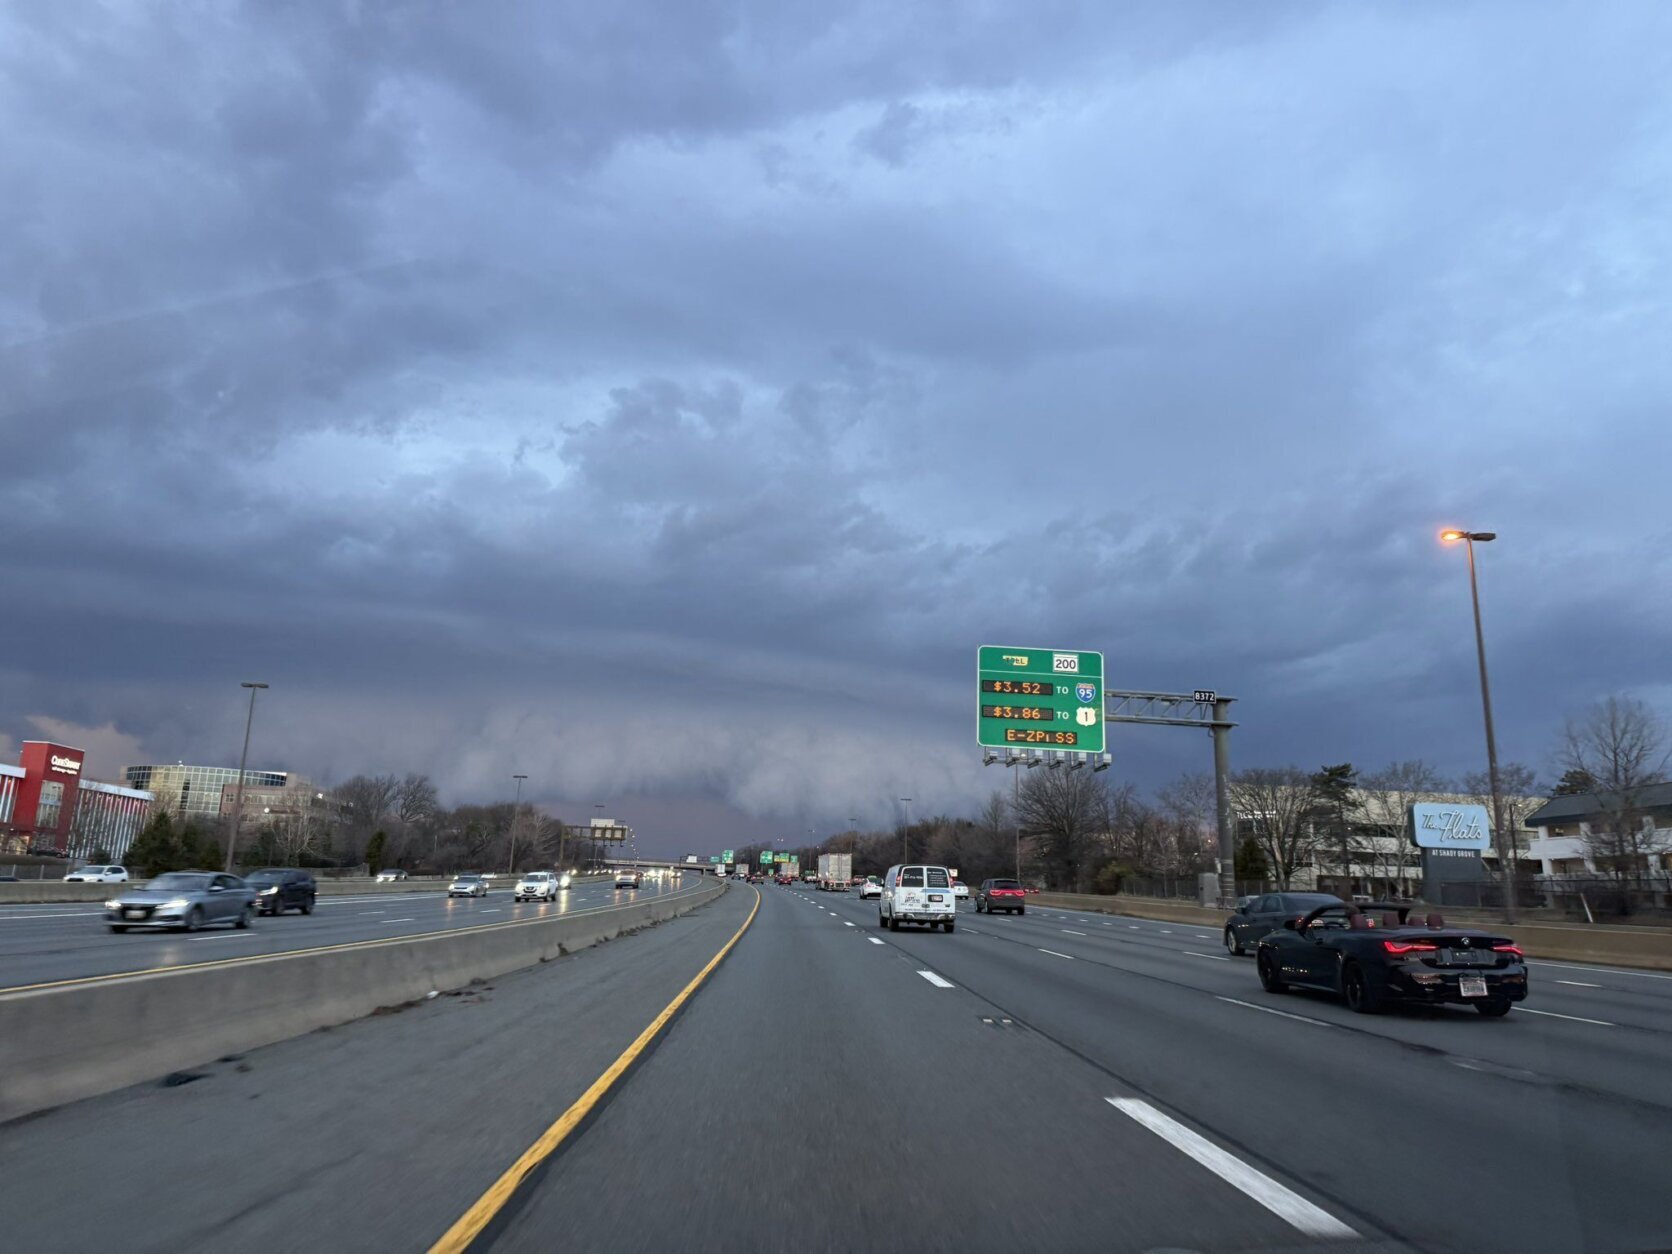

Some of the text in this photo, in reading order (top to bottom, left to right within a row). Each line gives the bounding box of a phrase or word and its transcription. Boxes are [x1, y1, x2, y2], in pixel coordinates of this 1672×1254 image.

[1055, 659, 1076, 670] 200
[993, 681, 1069, 694] $3.52 TO
[1079, 688, 1092, 698] 95
[1195, 692, 1214, 700] 8372
[993, 706, 1070, 720] $3.86 TO
[1007, 730, 1074, 744] E-ZPSS
[1438, 811, 1482, 842] Flats
